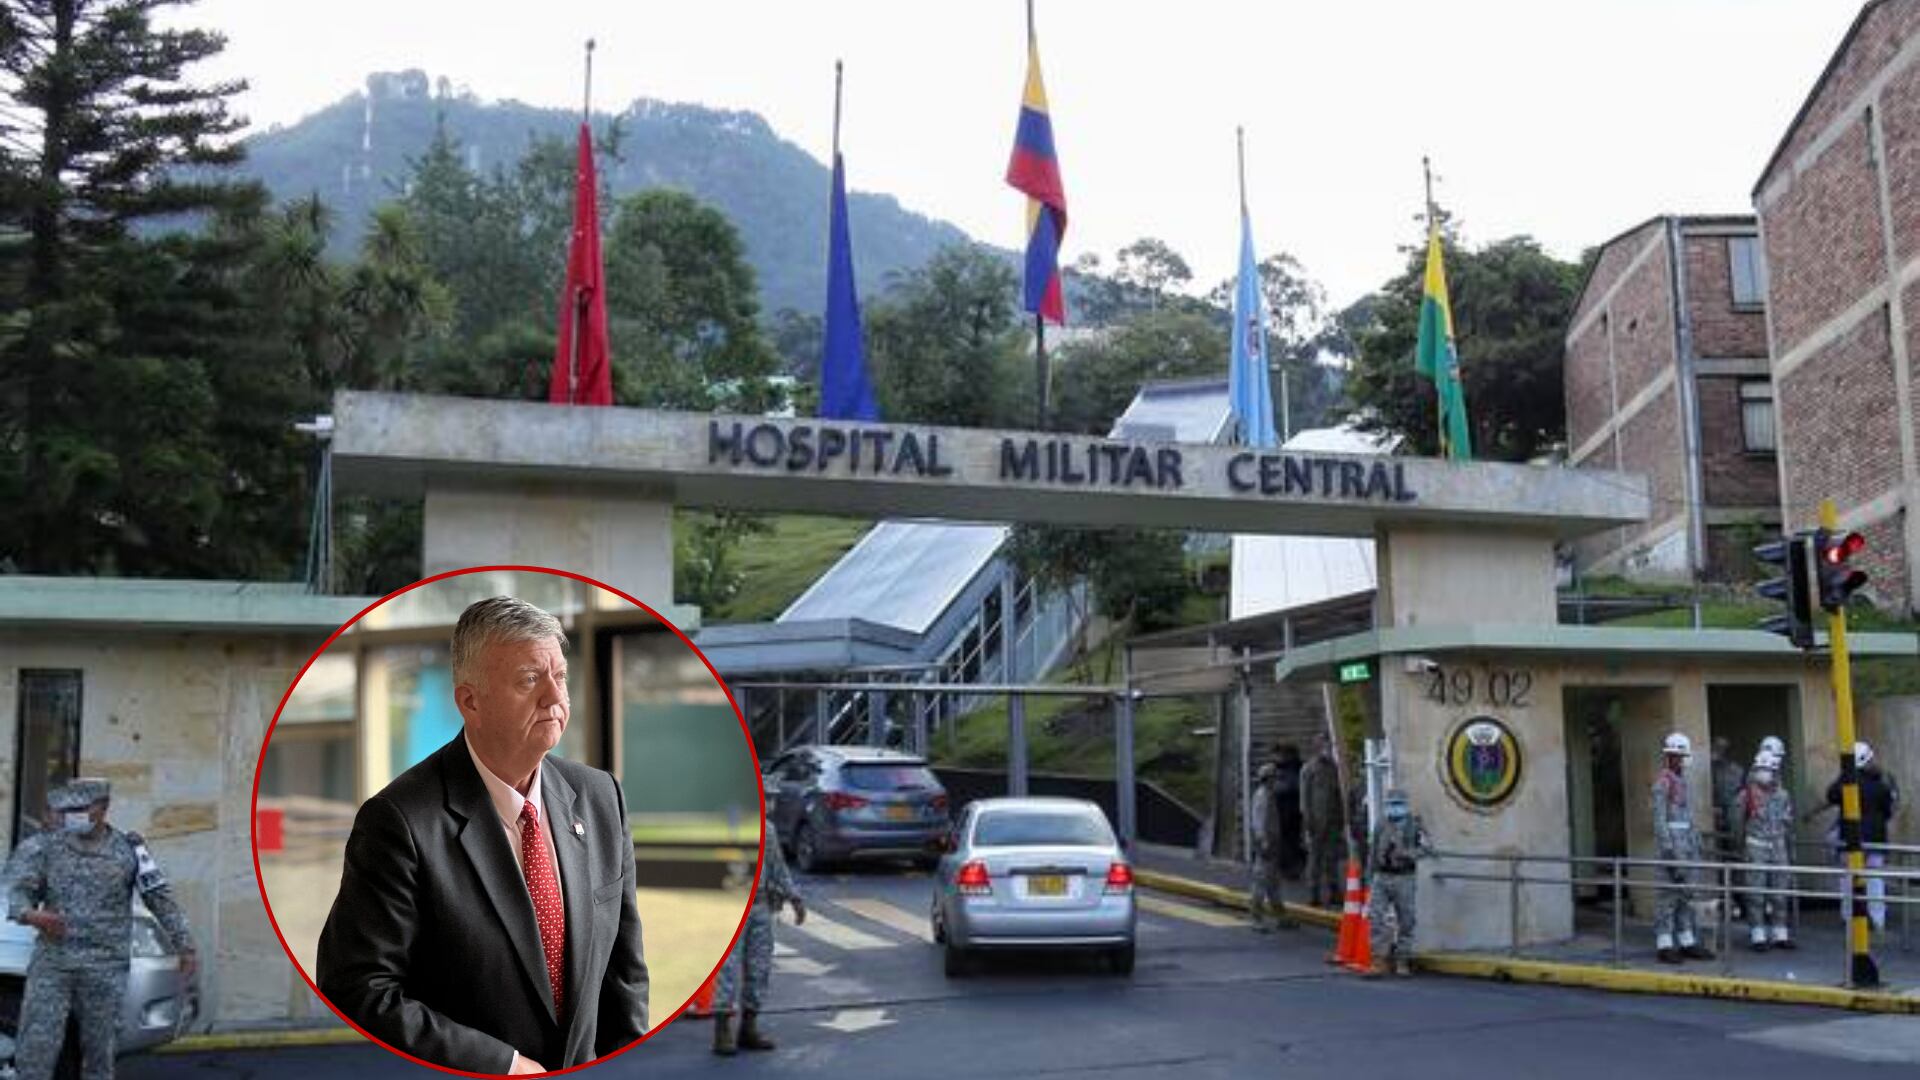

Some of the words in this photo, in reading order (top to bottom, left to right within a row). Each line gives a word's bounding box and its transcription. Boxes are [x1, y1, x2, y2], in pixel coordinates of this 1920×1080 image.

[708, 420, 952, 476] HOSPITAL
[1000, 437, 1184, 489] MILITAR
[1228, 451, 1418, 502] CENTRAL
[1488, 667, 1533, 708] 02
